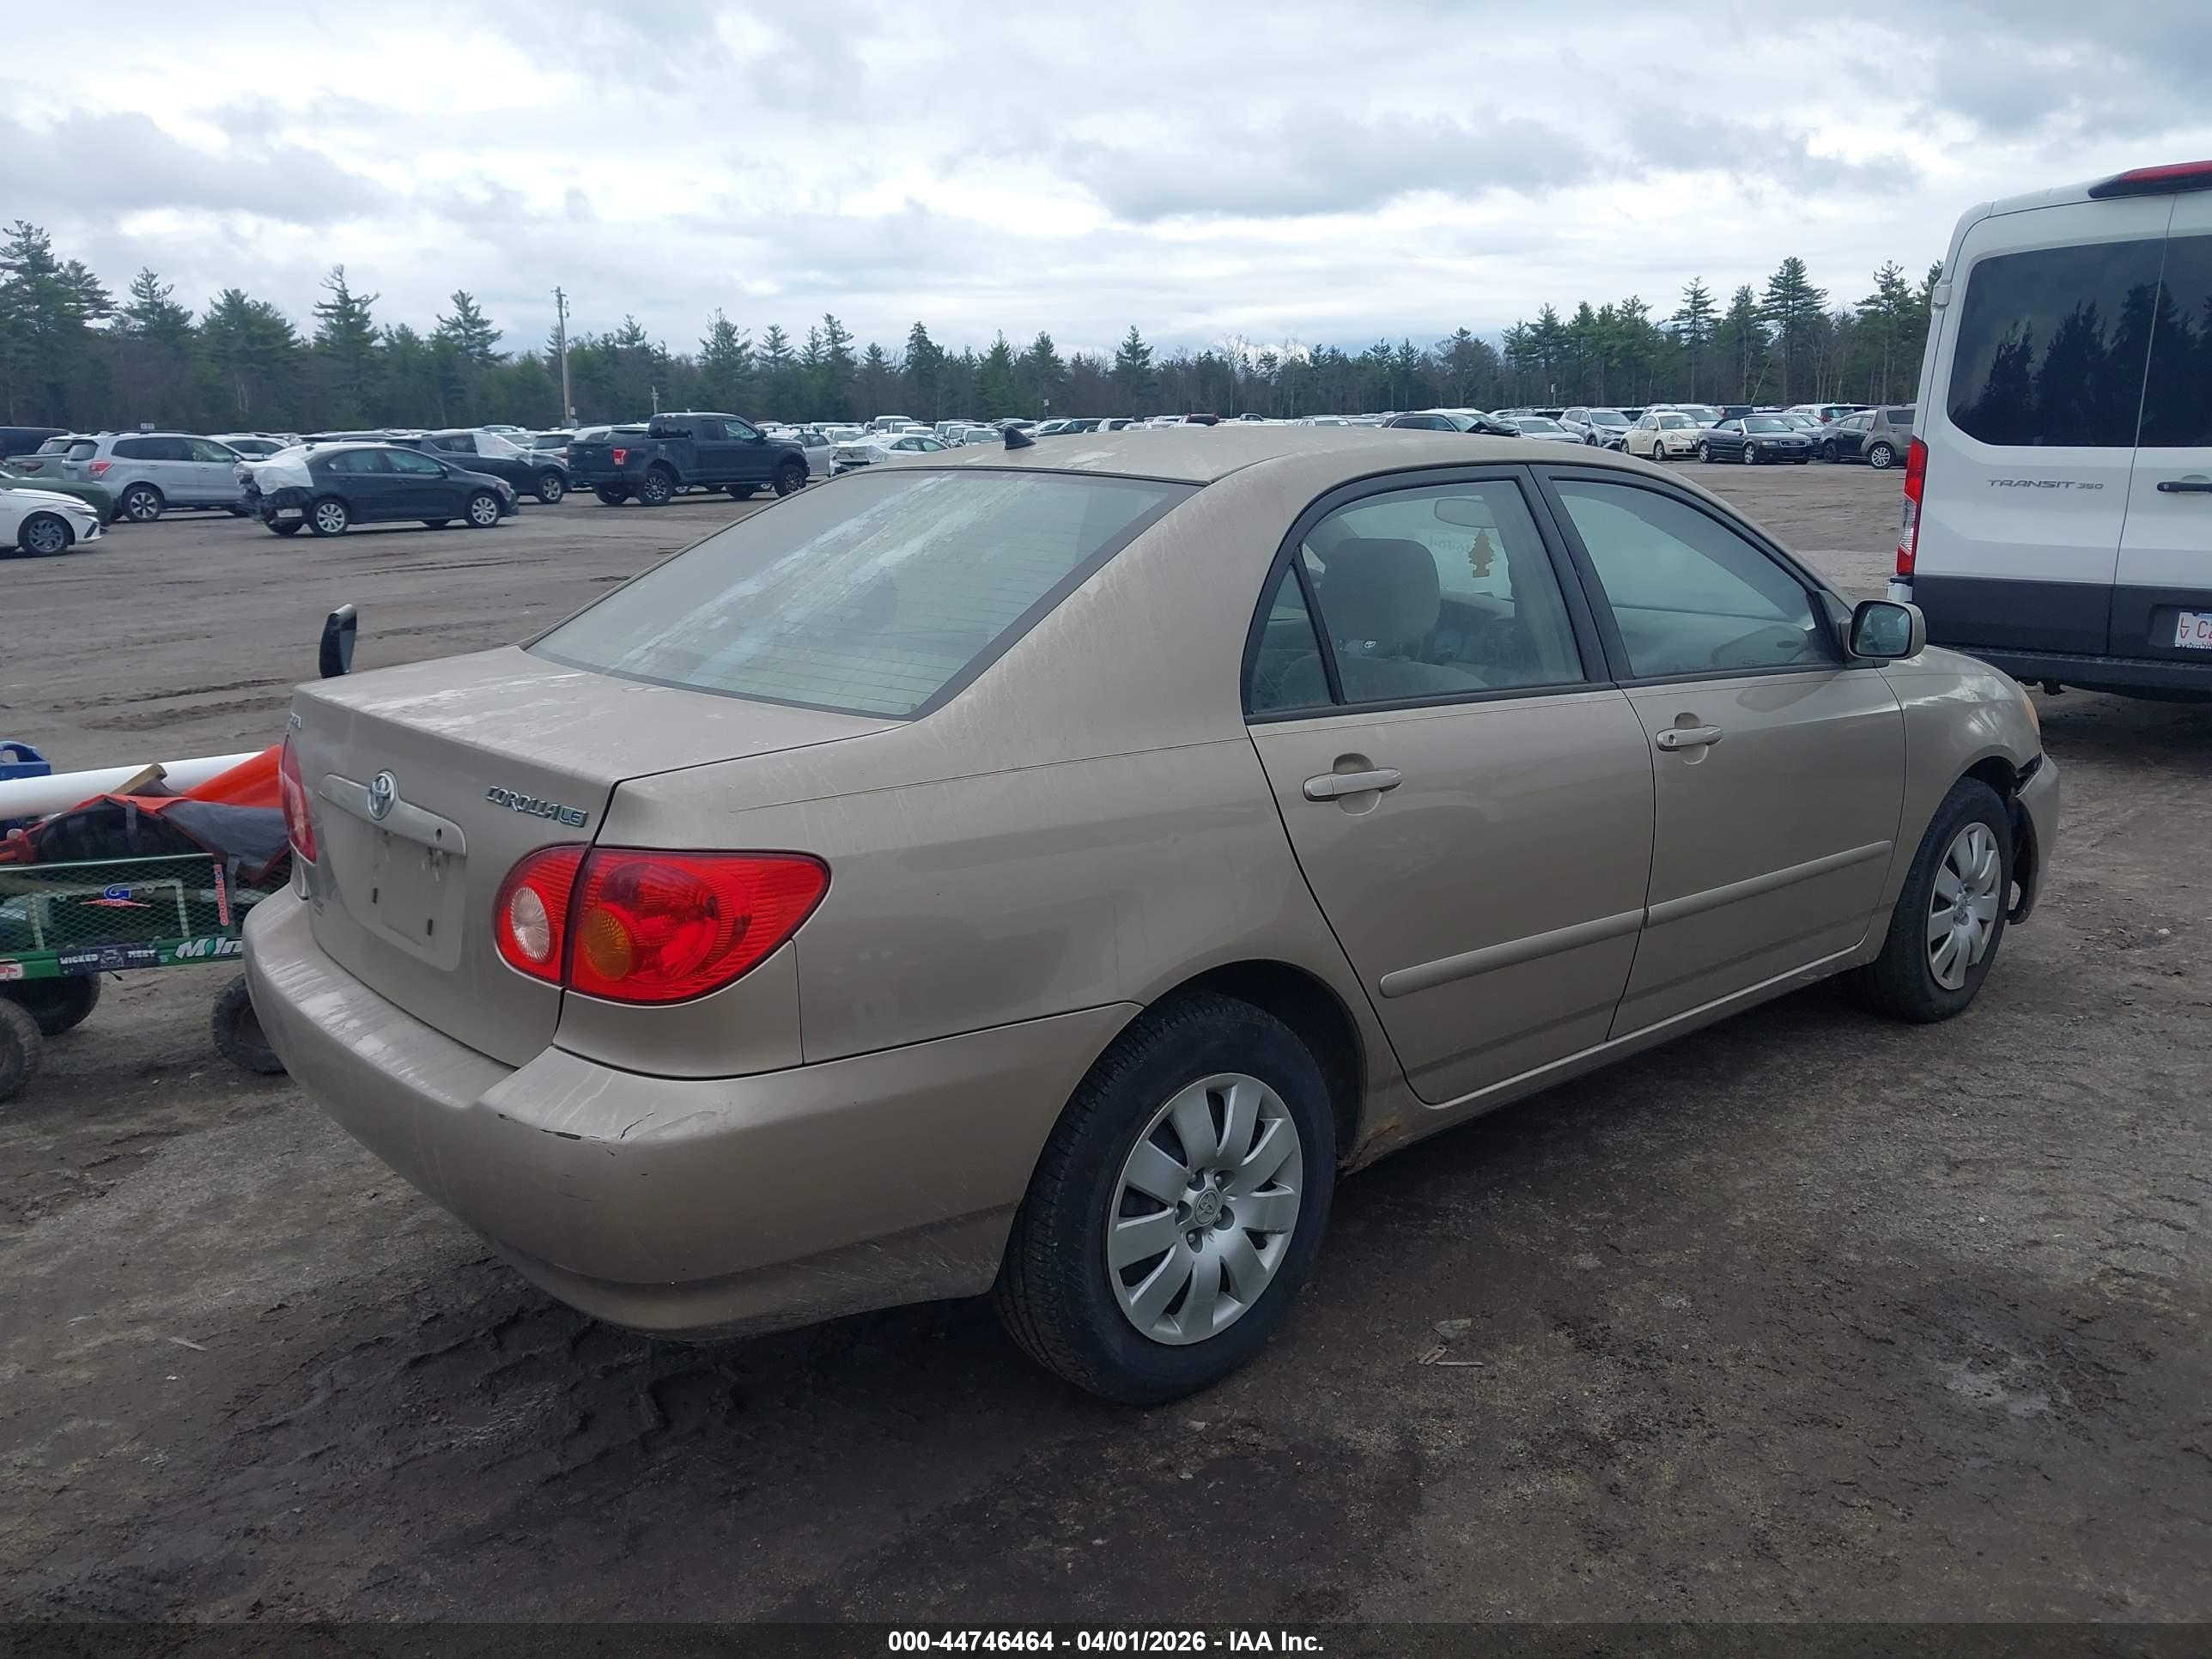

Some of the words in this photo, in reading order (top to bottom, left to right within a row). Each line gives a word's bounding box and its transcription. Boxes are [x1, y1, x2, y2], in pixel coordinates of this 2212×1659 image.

[1987, 479, 2075, 489] TRANSIT
[486, 785, 562, 821] COROLLA
[559, 805, 588, 828] LE
